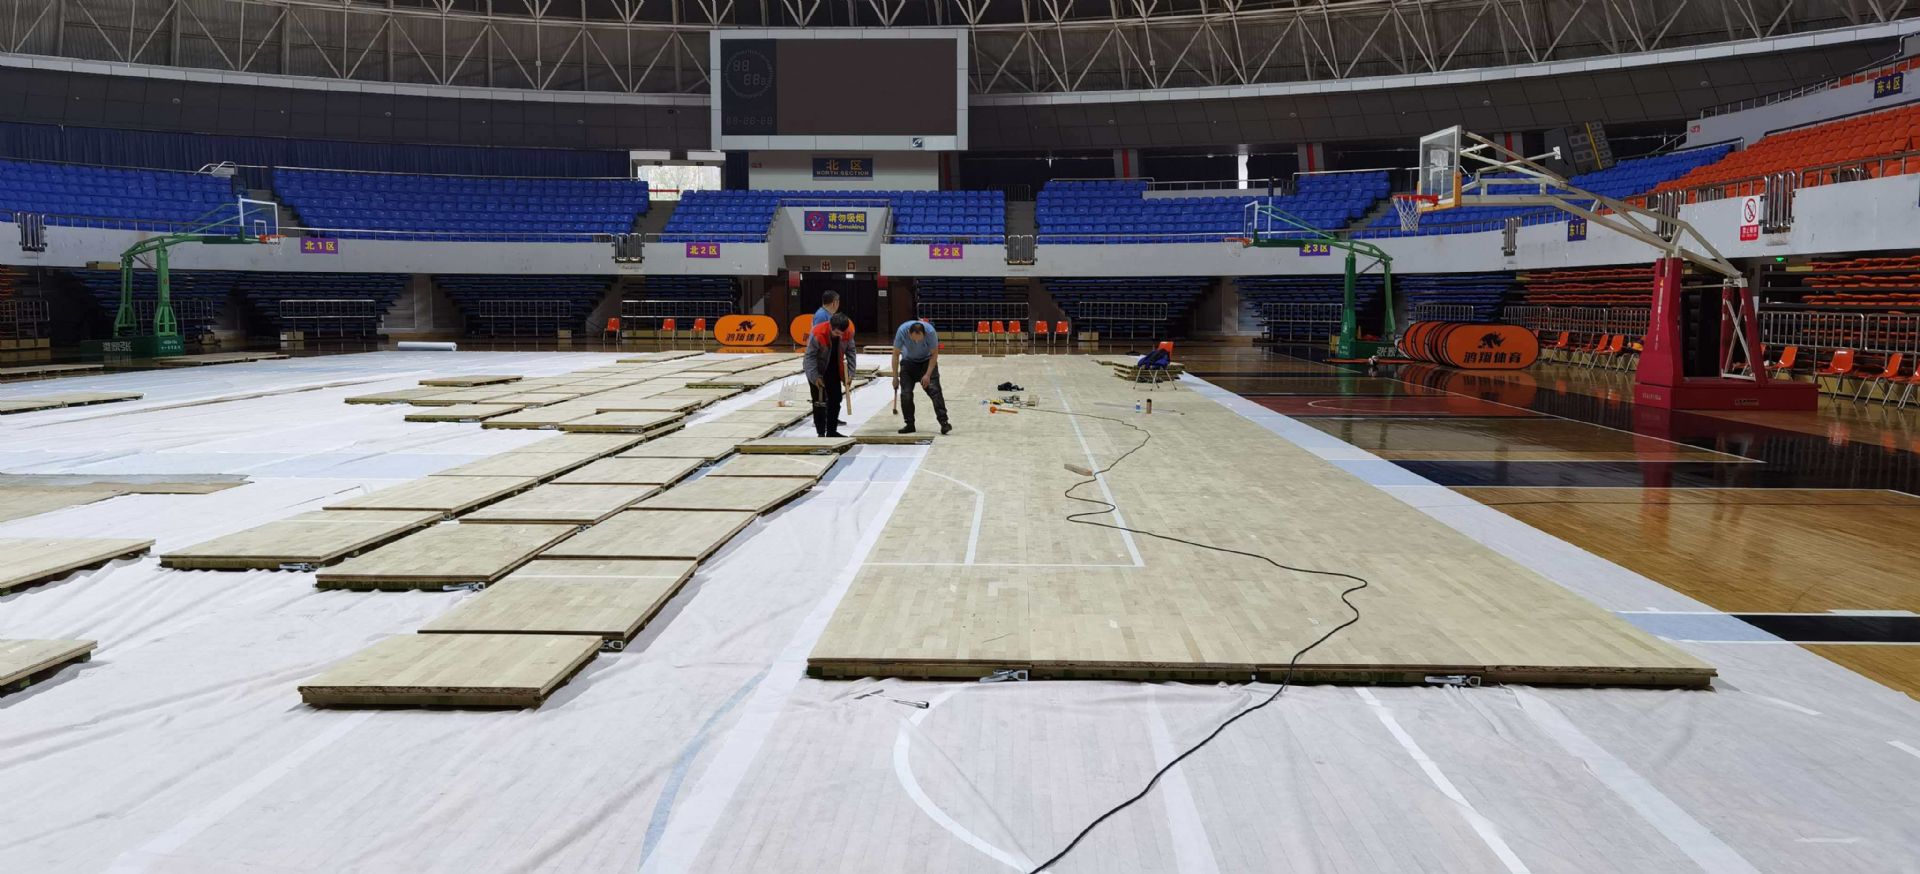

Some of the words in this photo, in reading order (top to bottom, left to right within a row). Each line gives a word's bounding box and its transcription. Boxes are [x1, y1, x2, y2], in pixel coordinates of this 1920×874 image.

[1876, 76, 1901, 94] 东4区
[828, 213, 865, 223] 请勿吸烟
[304, 240, 335, 251] 北1区
[689, 245, 718, 255] 北2区
[1302, 243, 1329, 253] 北3区
[932, 247, 961, 257] 北2区
